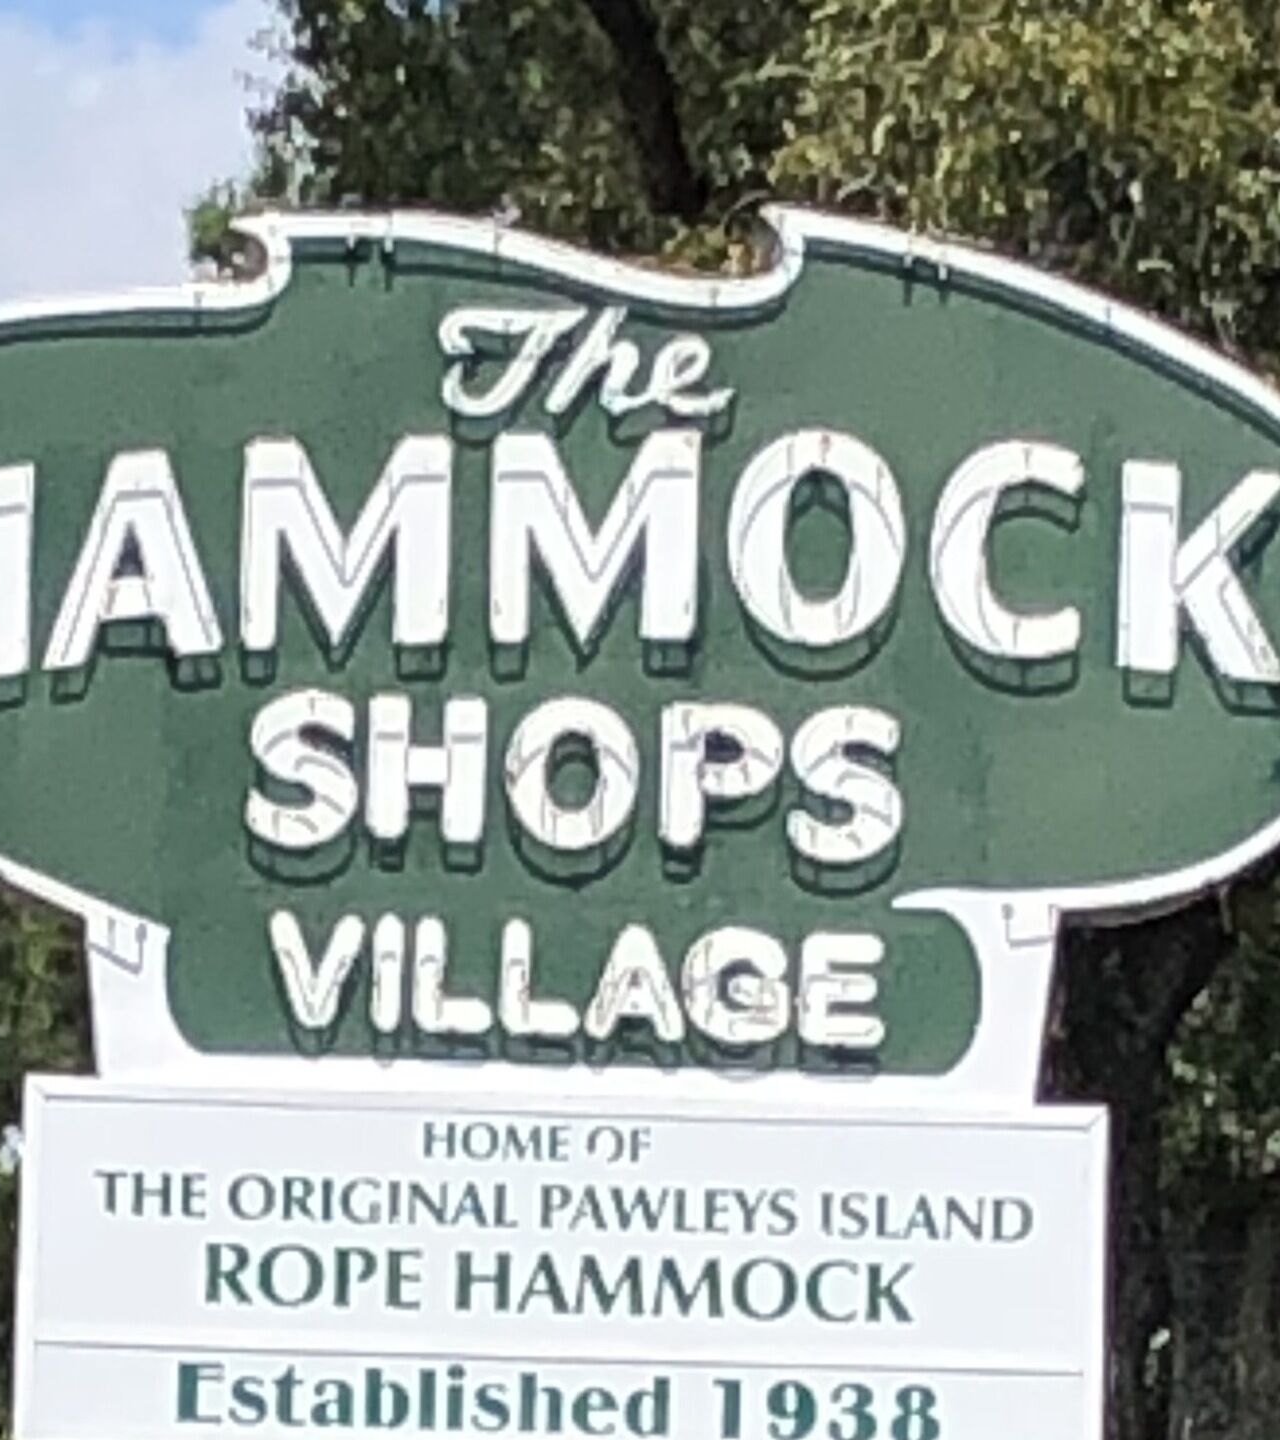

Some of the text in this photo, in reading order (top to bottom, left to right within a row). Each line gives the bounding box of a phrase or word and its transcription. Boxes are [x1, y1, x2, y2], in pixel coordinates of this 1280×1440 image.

[437, 304, 734, 420] The
[245, 690, 904, 882] SHOPS
[270, 908, 886, 1068] VILLAGE
[424, 1122, 653, 1165] HOME OF
[95, 1170, 1034, 1243] THE ORIGINAL PAWLEYS ISLAND
[205, 1243, 915, 1324] ROPE HAMMOCK
[177, 1362, 672, 1437] Established
